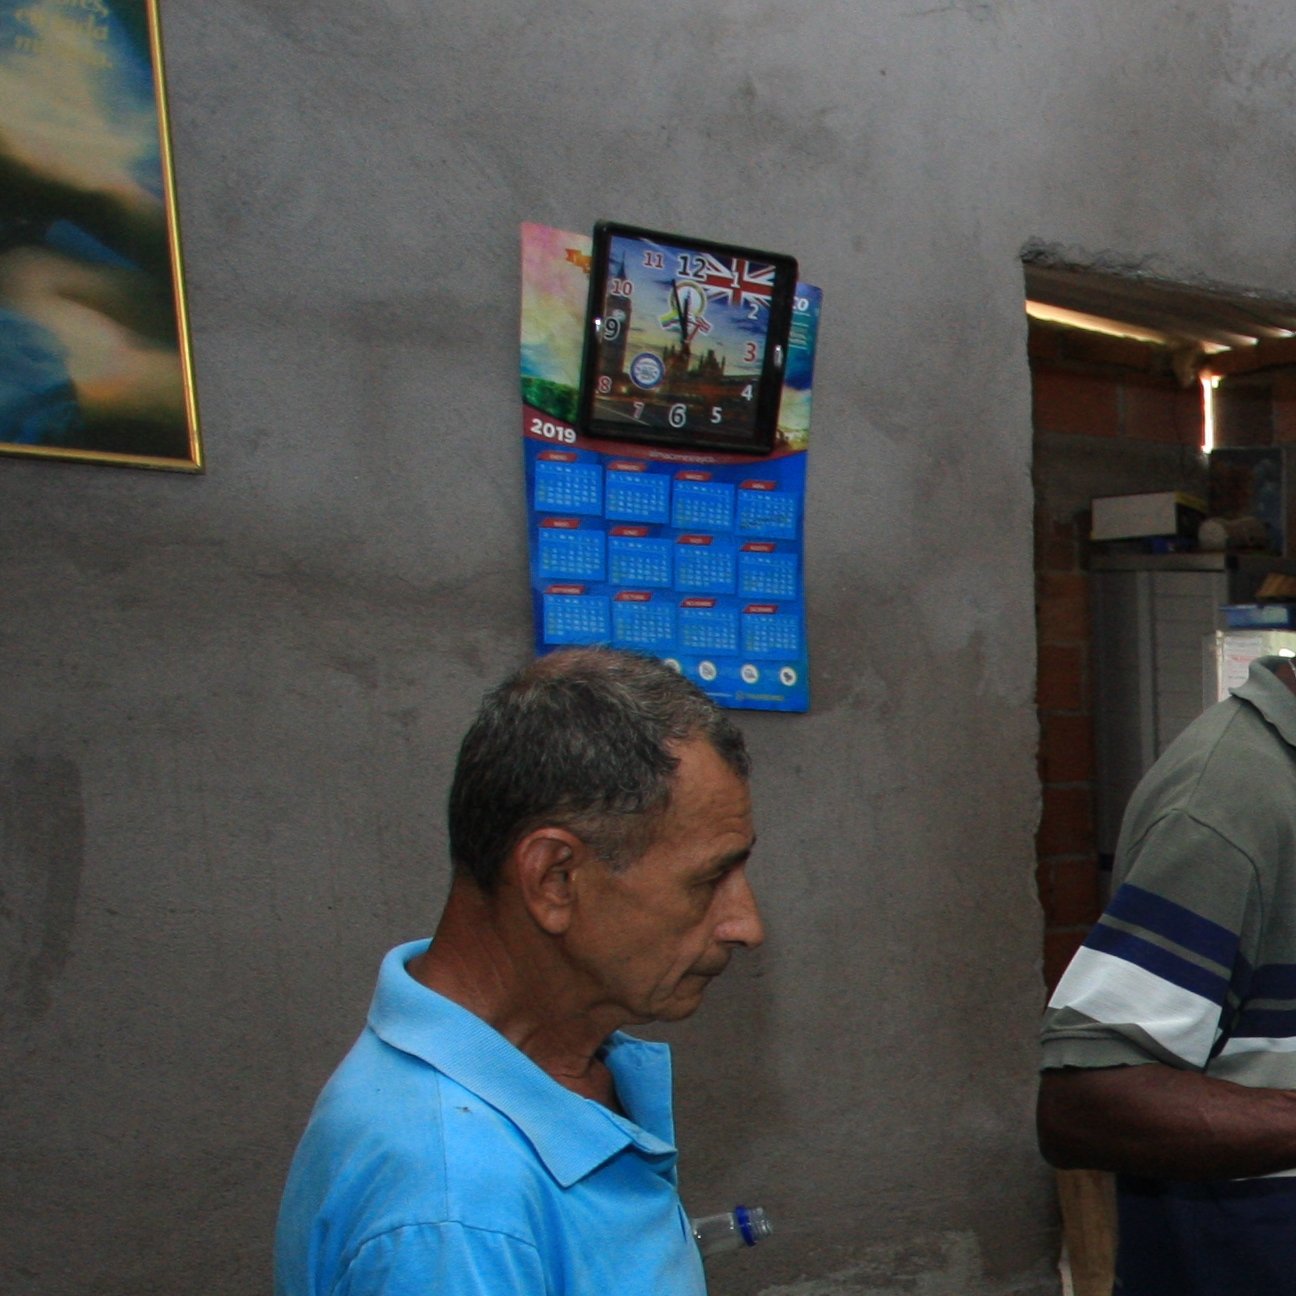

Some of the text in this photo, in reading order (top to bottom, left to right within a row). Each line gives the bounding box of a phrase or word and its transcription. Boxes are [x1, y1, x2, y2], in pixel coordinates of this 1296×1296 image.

[643, 250, 664, 269] 11
[677, 254, 708, 282] 12
[611, 278, 633, 297] 10
[748, 304, 759, 320] 2
[604, 317, 621, 341] 9
[744, 342, 758, 362] 3
[598, 375, 613, 394] 8
[740, 384, 753, 401] 4
[632, 401, 644, 420] 7
[668, 402, 687, 428] 6
[710, 407, 723, 424] 5
[530, 418, 577, 444] 2019
